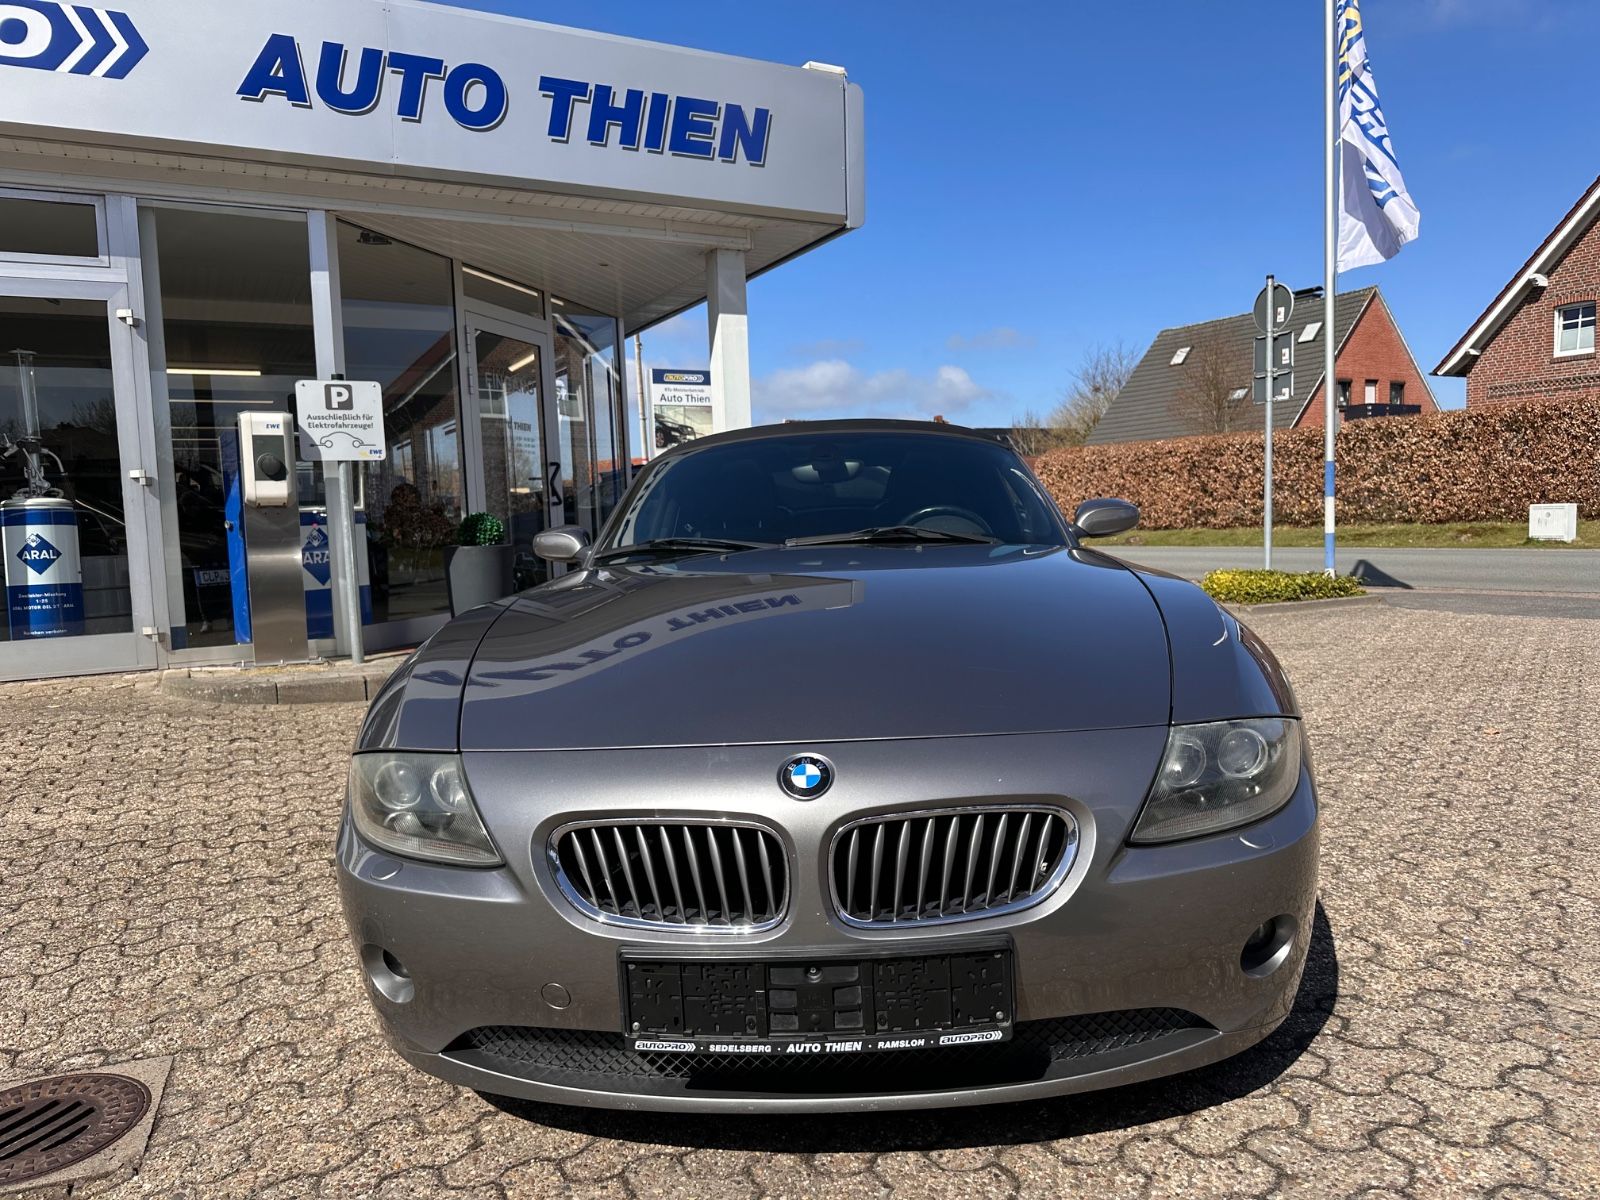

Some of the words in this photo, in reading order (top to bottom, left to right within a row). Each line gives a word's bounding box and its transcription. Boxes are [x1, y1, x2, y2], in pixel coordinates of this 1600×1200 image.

[236, 33, 508, 132] AUTO
[538, 75, 772, 167] THIEN
[330, 386, 350, 409] P
[660, 393, 683, 403] Auto
[685, 394, 710, 403] Thien
[306, 413, 361, 421] Ausschließlich
[362, 413, 373, 421] für
[307, 422, 374, 430] Elektrofahrzeuge!
[22, 549, 57, 561] ARAL
[787, 757, 827, 771] BMW
[709, 1044, 772, 1053] SEDELSBERG
[786, 1042, 821, 1053] AUTO
[825, 1041, 863, 1052] THIEN
[877, 1038, 925, 1049] RAMSLOH
